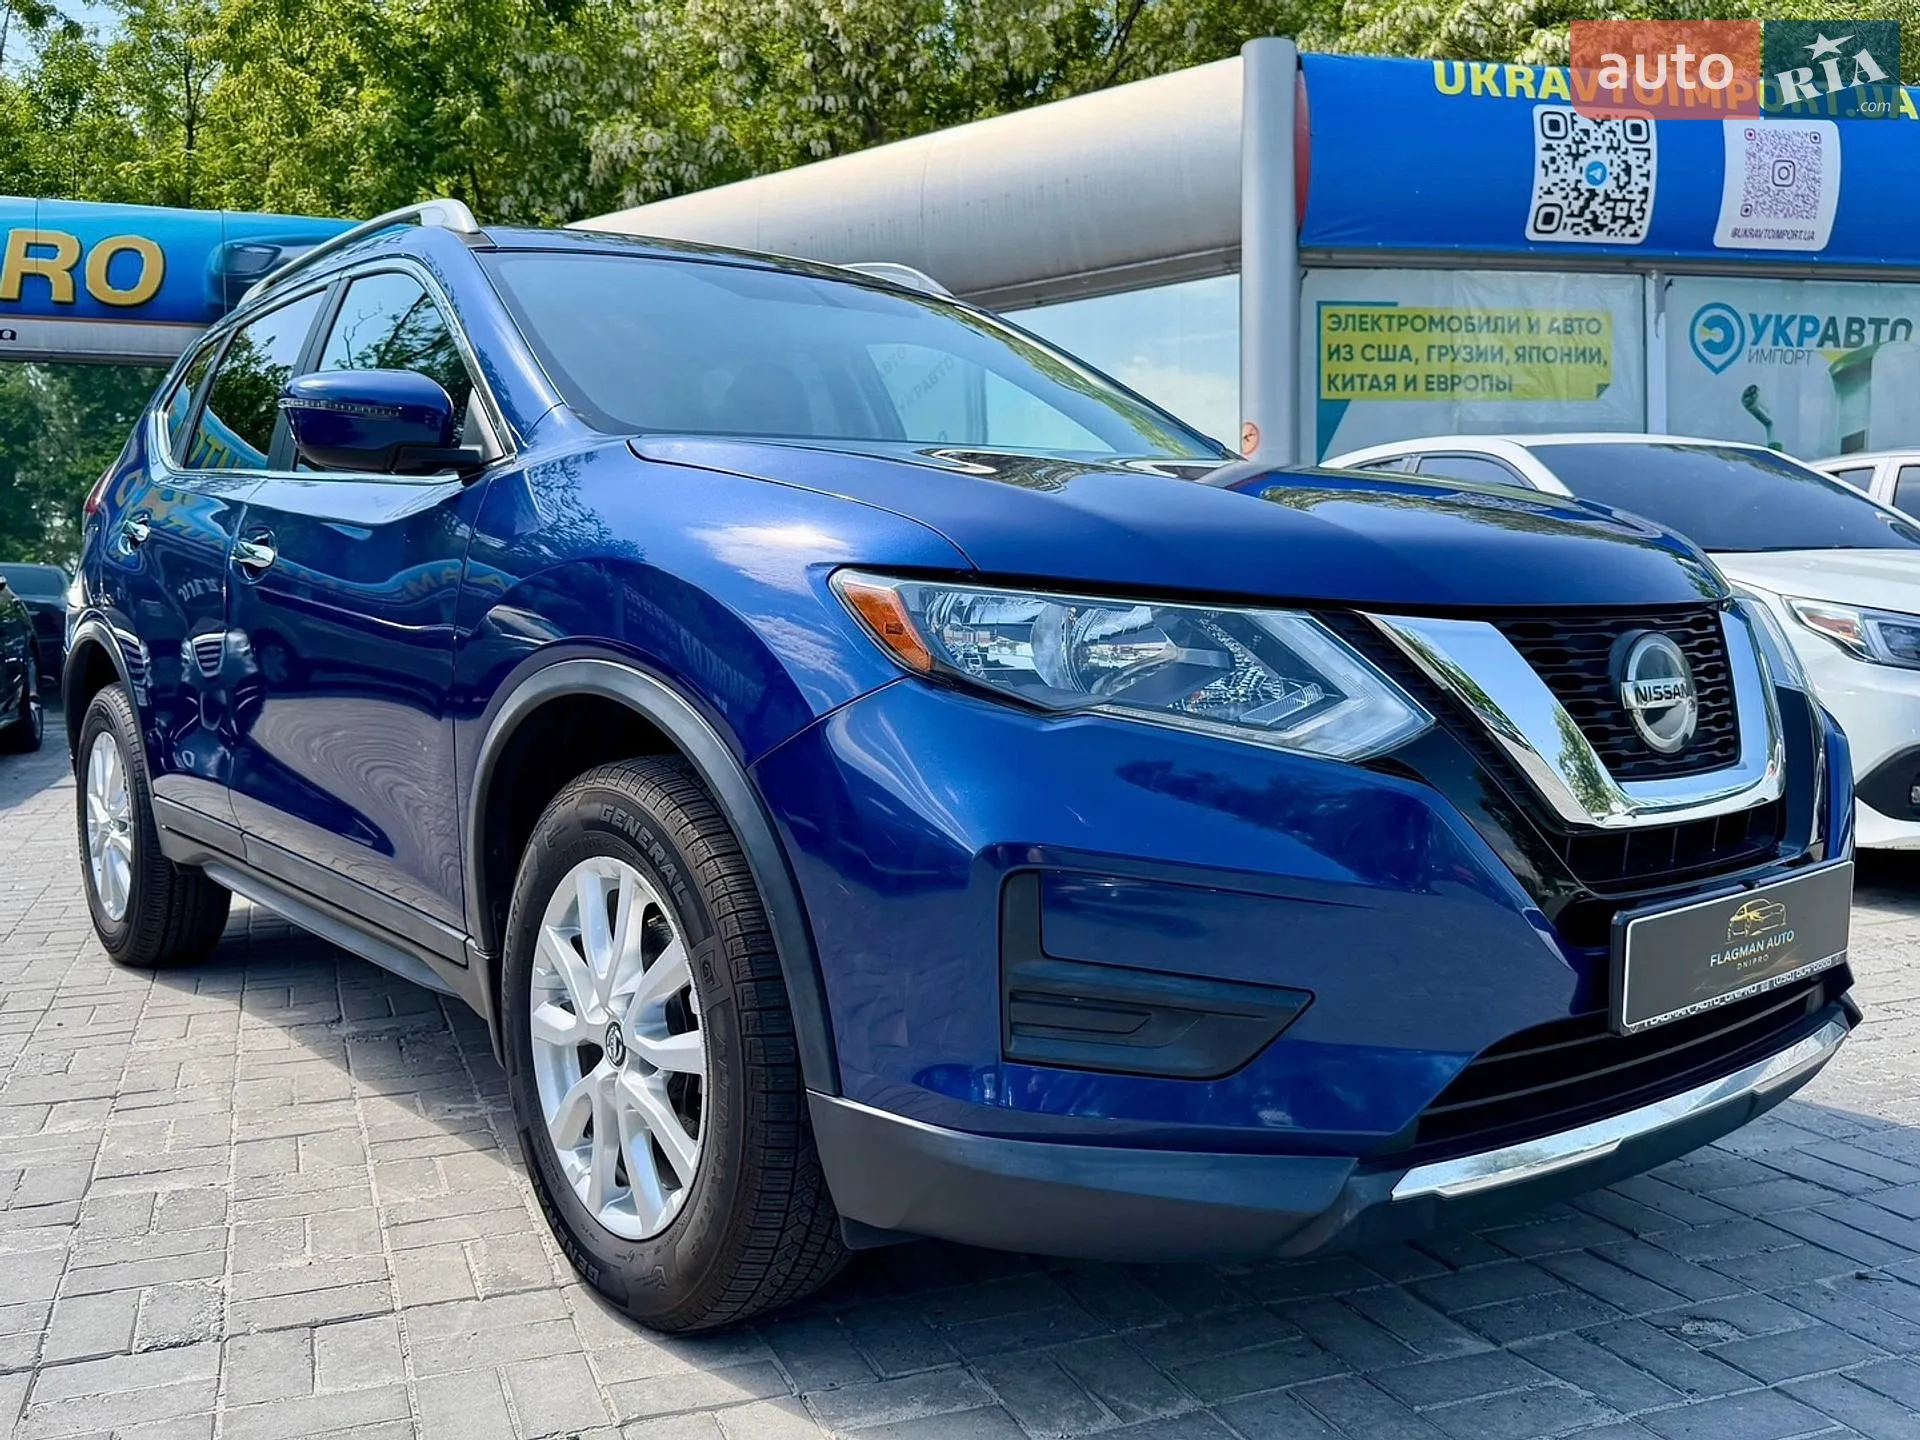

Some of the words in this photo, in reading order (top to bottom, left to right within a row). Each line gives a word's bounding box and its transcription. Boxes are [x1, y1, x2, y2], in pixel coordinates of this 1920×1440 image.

[1326, 313, 1521, 335] ЭЛЕКТРОМОБИЛИ
[1526, 317, 1541, 335] И
[1547, 316, 1602, 335] АВТО
[1748, 312, 1913, 349] УКРАВТО
[1326, 343, 1355, 363] ИЗ
[1361, 344, 1419, 366] США,
[1426, 345, 1510, 366] ГРУЗИИ,
[1515, 346, 1608, 367] ЯПОНИИ,
[1747, 348, 1814, 366] ИМПОРТ
[1326, 373, 1397, 393] КИТАЯ
[1403, 374, 1418, 393] И
[1424, 373, 1513, 393] ЕВРОПЫ
[1634, 680, 1689, 703] NISSAN
[599, 802, 688, 906] GENERAL
[1709, 940, 1765, 967] FLAGMAN
[1766, 930, 1796, 949] AUTO
[1736, 954, 1770, 971] DNIPRO
